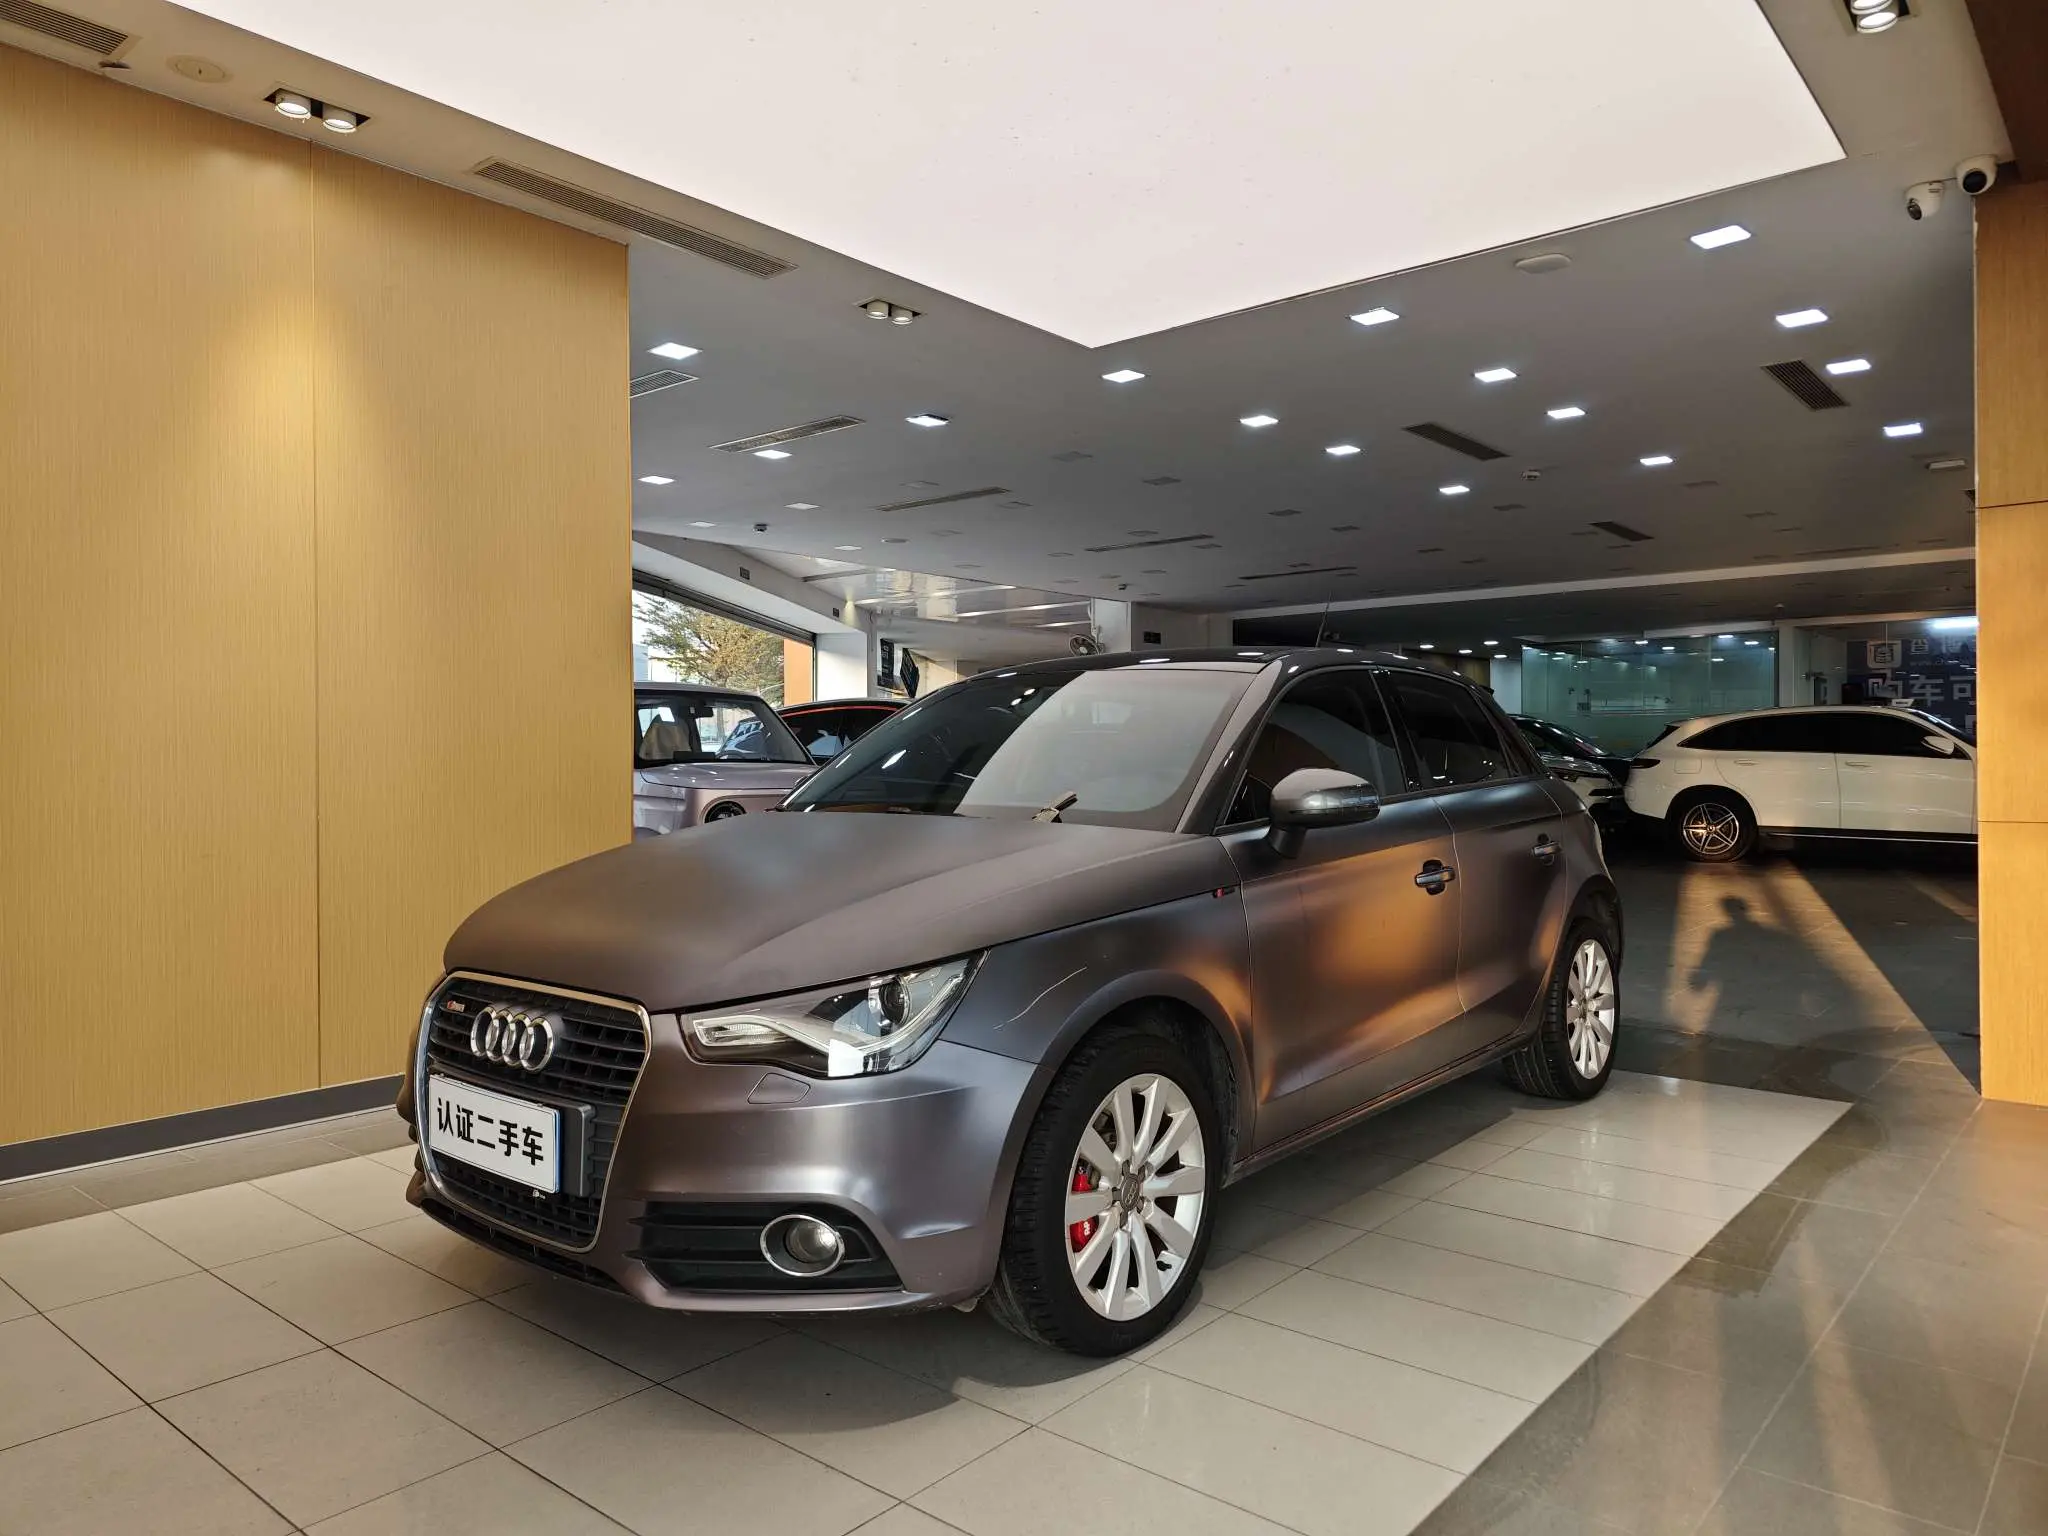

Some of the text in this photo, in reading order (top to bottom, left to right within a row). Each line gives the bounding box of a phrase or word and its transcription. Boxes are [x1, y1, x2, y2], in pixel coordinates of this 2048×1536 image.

[436, 1096, 545, 1167] 认证二手车
